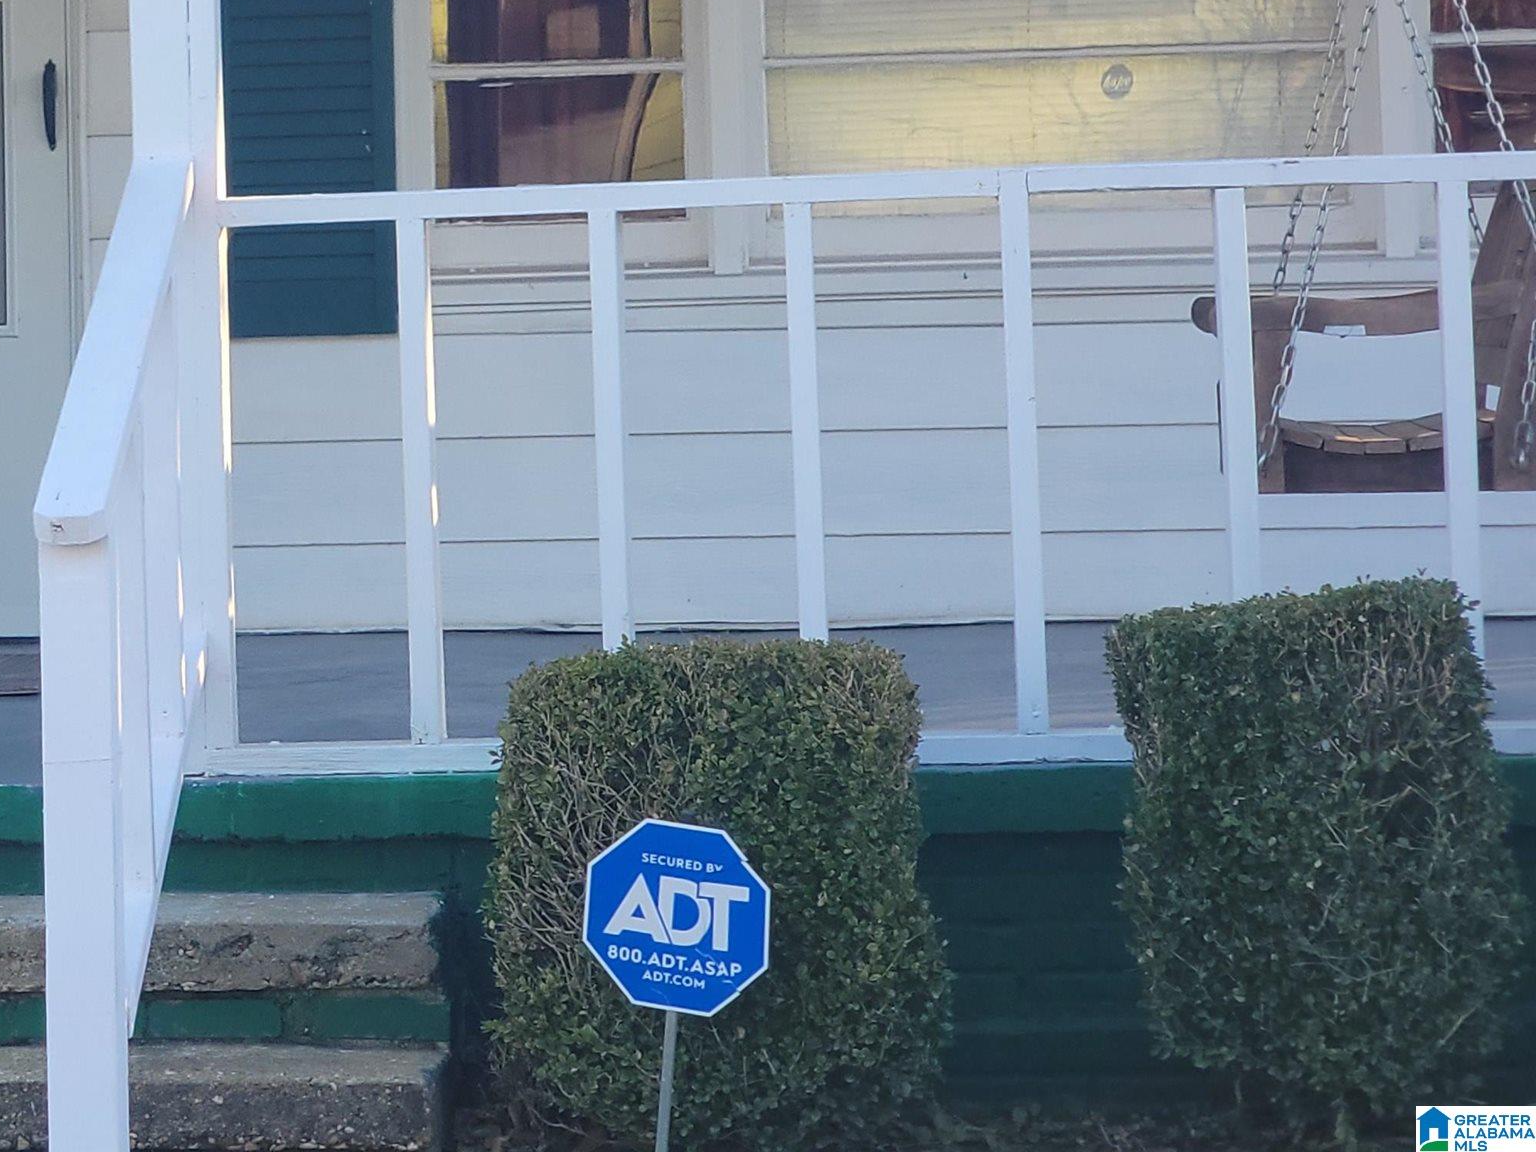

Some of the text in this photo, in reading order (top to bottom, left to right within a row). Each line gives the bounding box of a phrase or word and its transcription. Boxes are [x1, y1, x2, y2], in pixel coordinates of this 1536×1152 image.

[641, 852, 723, 873] SECURED BY
[603, 872, 750, 952] ADT
[607, 945, 742, 977] 800.ADT.ASAP
[642, 970, 706, 990] ADT.COM
